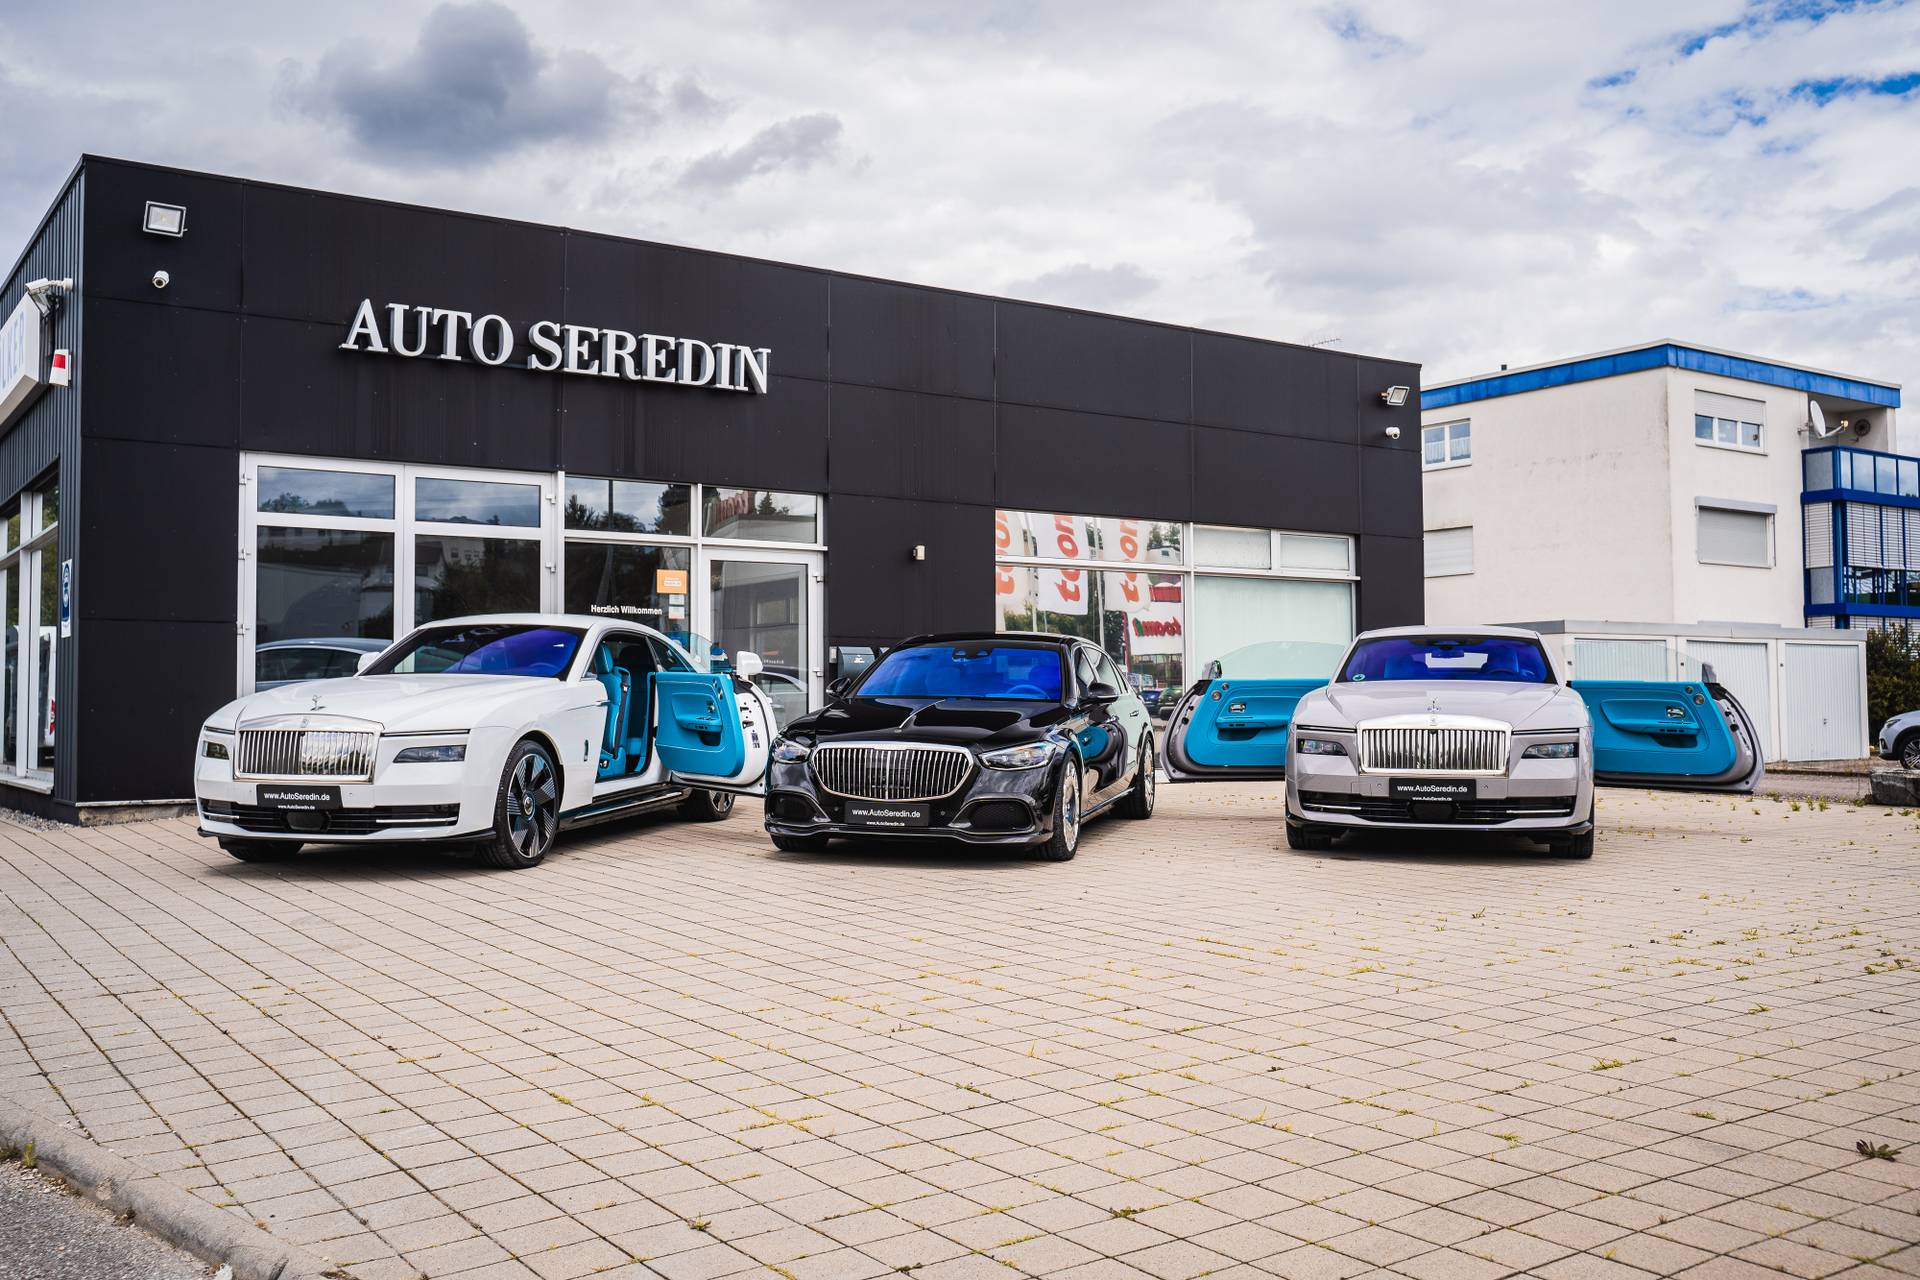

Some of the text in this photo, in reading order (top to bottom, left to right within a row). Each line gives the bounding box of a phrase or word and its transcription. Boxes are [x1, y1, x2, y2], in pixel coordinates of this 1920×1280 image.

[0, 311, 24, 389] LKER
[339, 298, 771, 395] AUTO SEREDIN
[590, 604, 663, 615] Herzlich Willkommen
[1396, 784, 1468, 793] www.AutoSeredin.de
[263, 792, 331, 801] www.AutoSeredin.de
[851, 808, 921, 818] www.AutoSeredin.de
